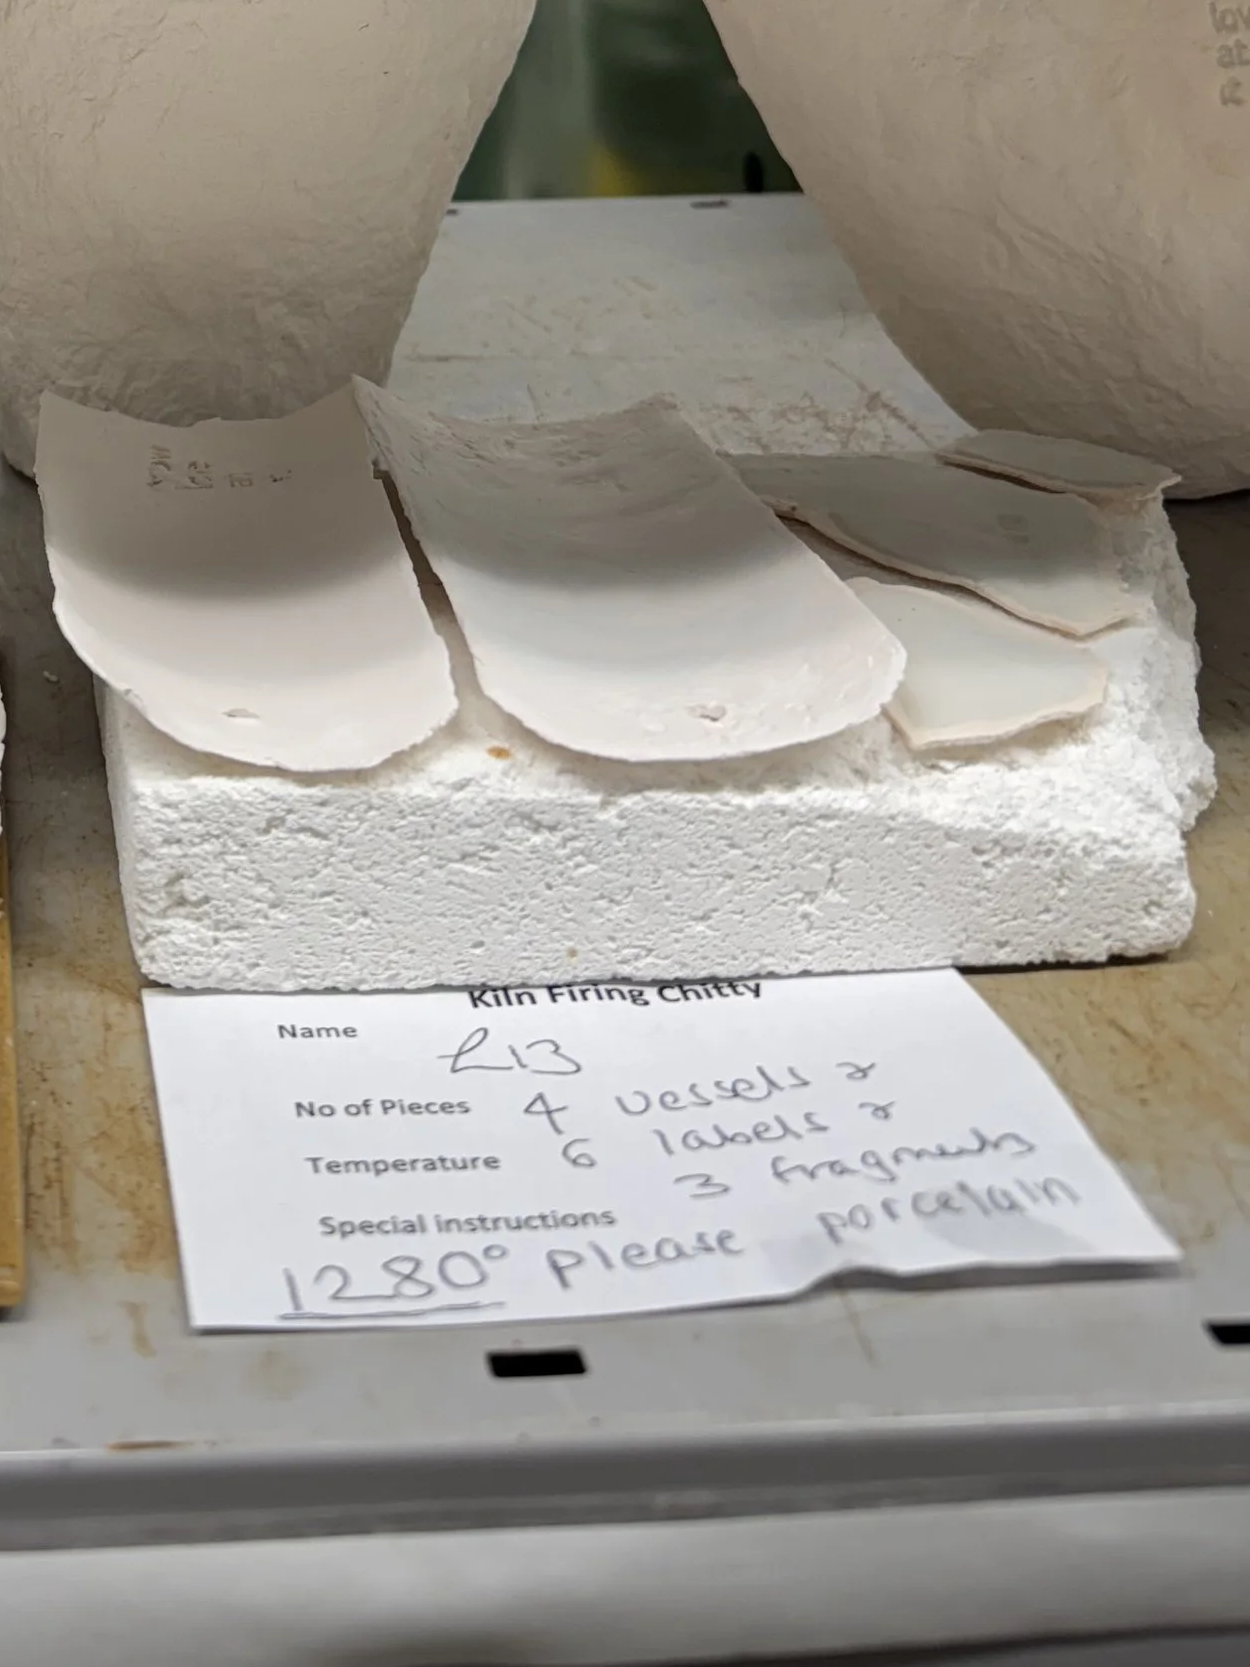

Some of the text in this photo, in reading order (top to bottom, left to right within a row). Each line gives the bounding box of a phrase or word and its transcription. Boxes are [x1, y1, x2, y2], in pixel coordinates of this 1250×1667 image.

[468, 980, 762, 1010] Kiln Firing Chitty
[277, 1023, 359, 1040] Name
[294, 1098, 472, 1118] No of Pieces
[522, 1091, 570, 1135] 4
[615, 1065, 813, 1117] vessels
[561, 1137, 597, 1169] 6
[652, 1110, 830, 1157] labels
[304, 1154, 502, 1178] Temperature
[674, 1127, 1038, 1200] 3 fragments
[319, 1210, 618, 1238] Special instructions
